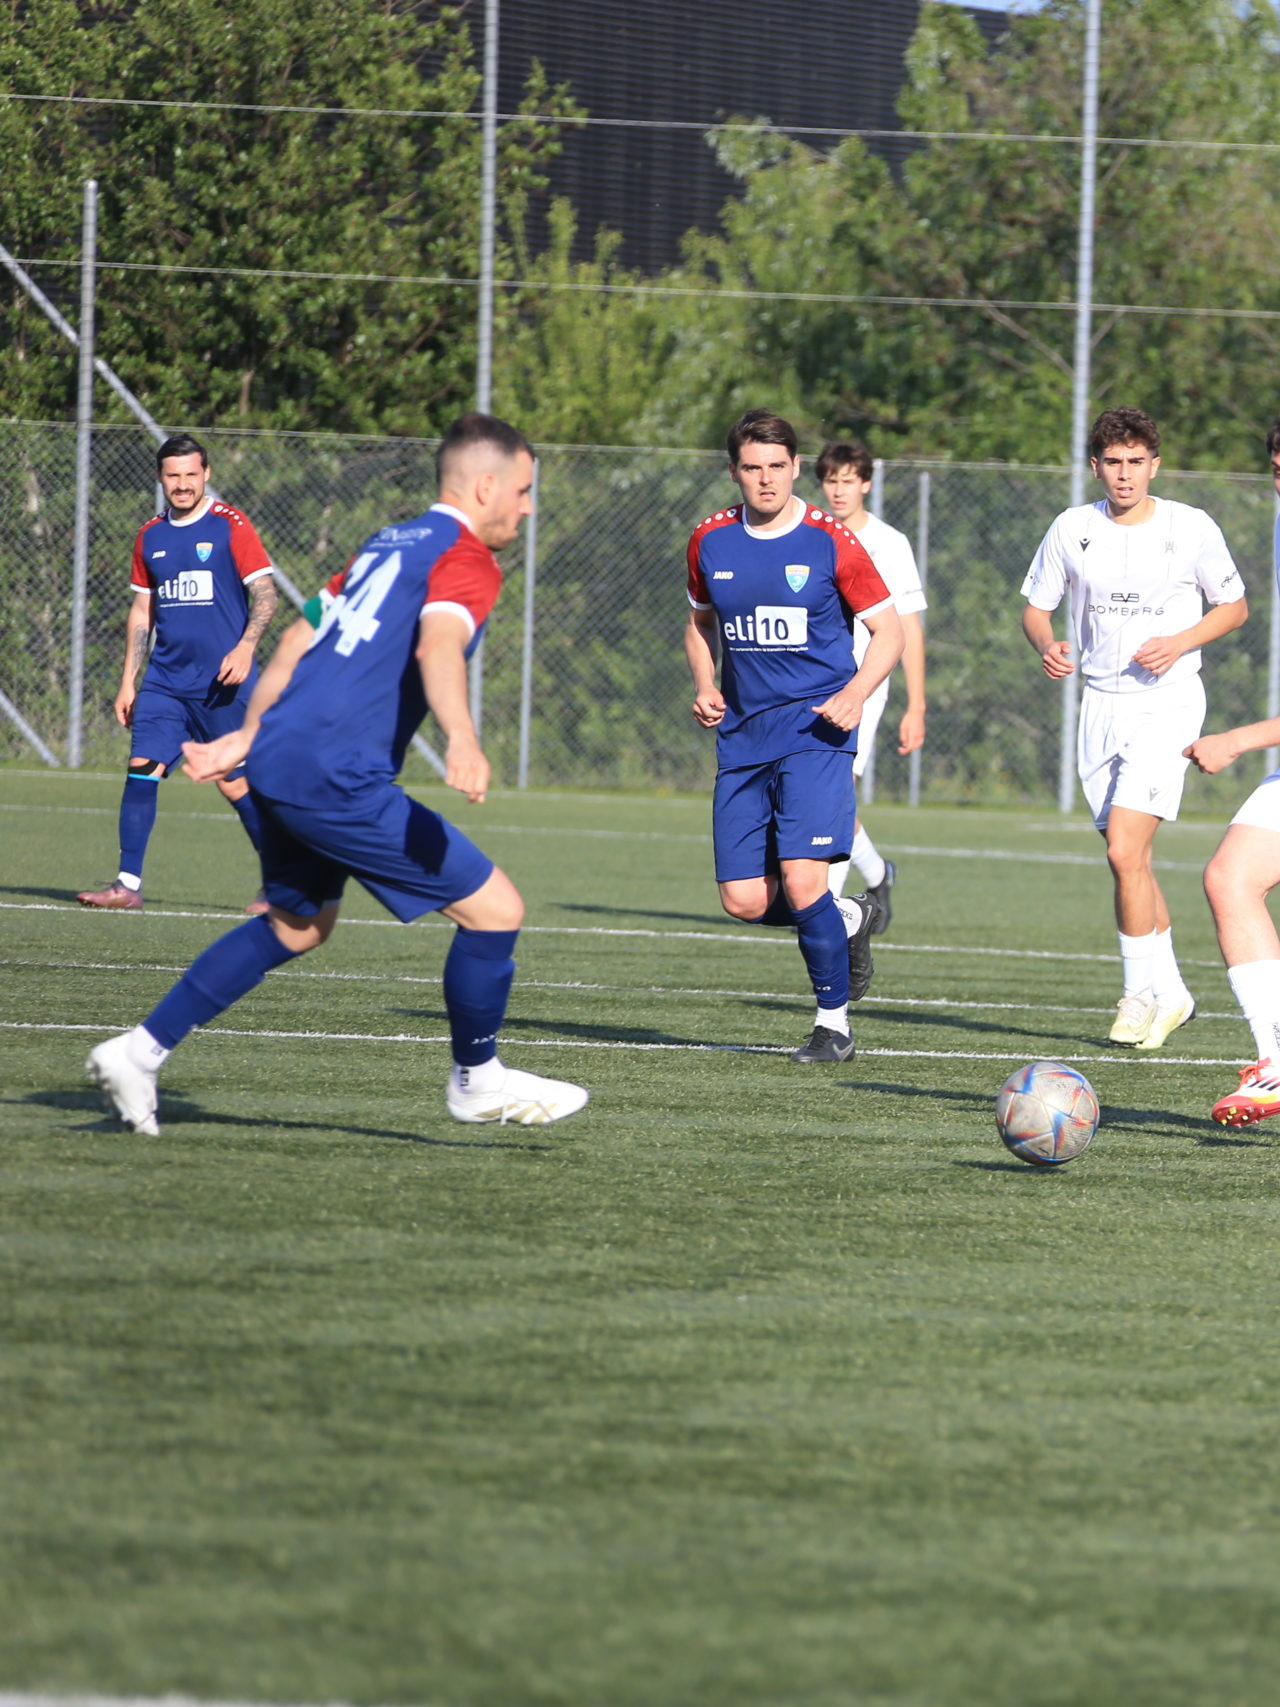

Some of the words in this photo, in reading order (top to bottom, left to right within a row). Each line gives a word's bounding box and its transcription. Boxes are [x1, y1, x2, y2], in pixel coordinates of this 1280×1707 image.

[712, 571, 734, 580] JAKO
[157, 578, 199, 600] eli10
[723, 614, 789, 642] eli10
